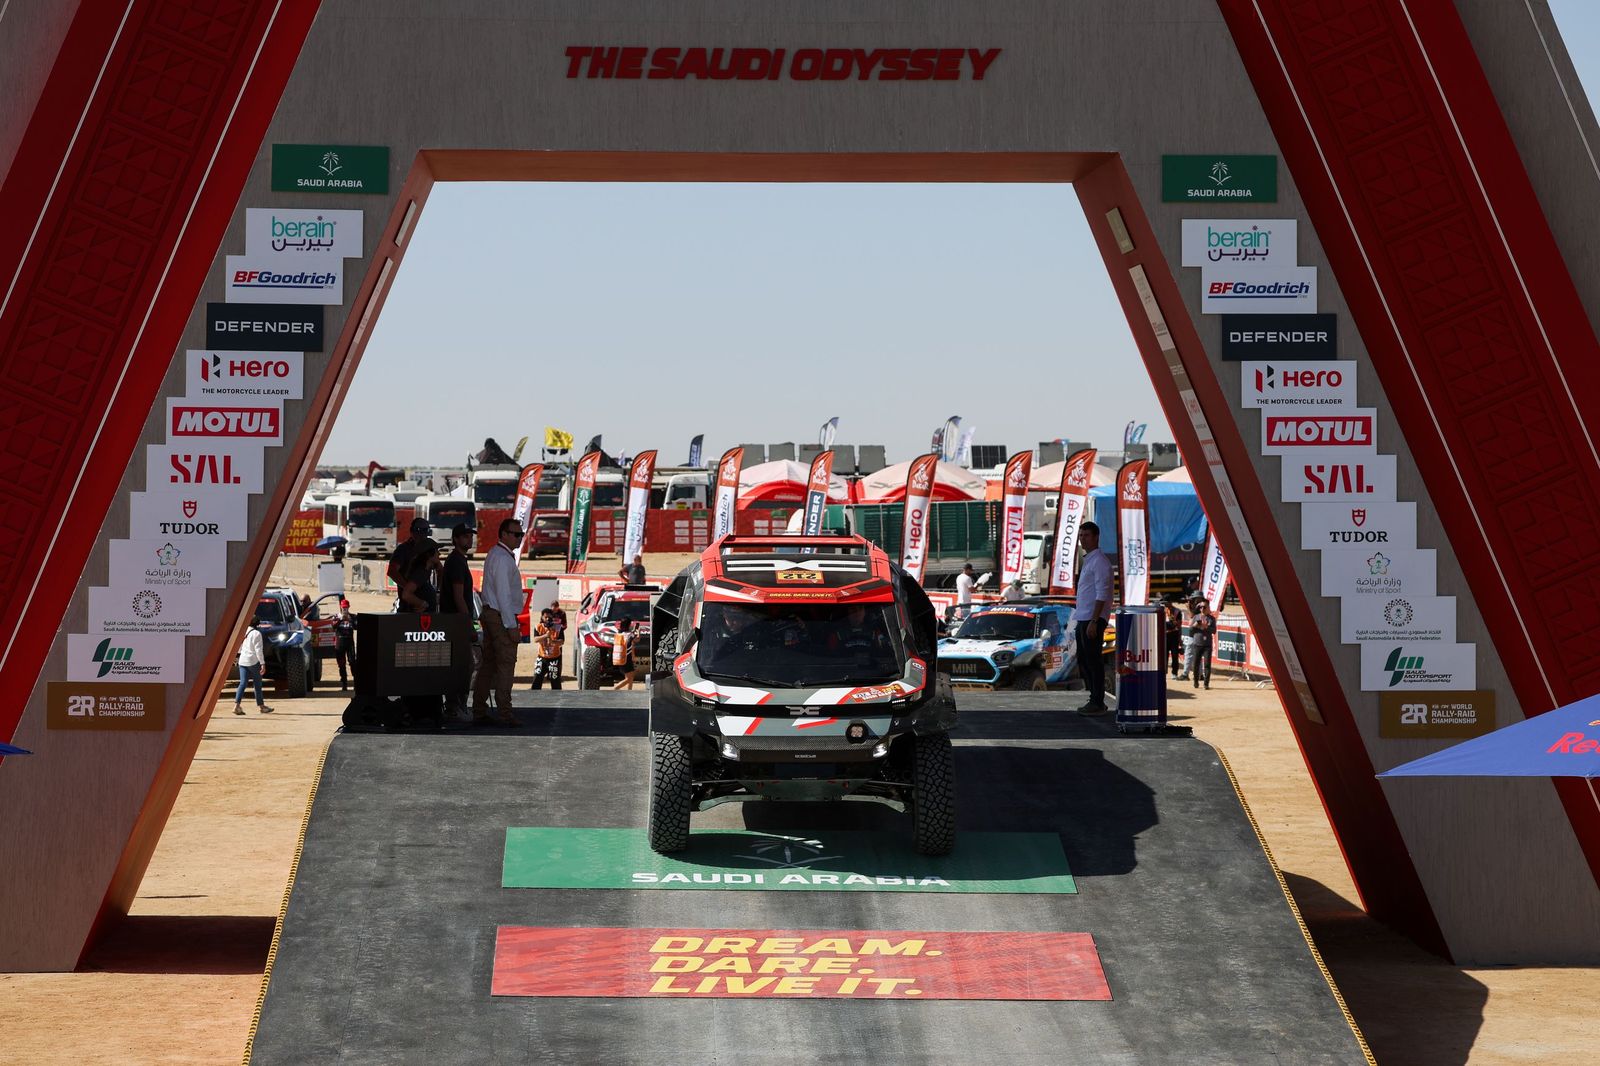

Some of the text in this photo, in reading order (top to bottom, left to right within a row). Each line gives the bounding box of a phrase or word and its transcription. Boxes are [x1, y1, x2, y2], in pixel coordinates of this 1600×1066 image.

[564, 46, 1002, 81] THE SAUDI ODYSSEY
[297, 178, 363, 188] SAUDI ARABIA
[1187, 189, 1252, 197] SAUDI ARABIA
[272, 215, 334, 238] berain
[1208, 225, 1269, 247] berain
[272, 238, 334, 252] بيرين
[1208, 247, 1269, 262] بيرين
[233, 270, 336, 285] BFGoodrich
[1209, 282, 1309, 294] BFGoodrich
[215, 320, 315, 334] DEFENDER
[1230, 331, 1328, 342] DEFENDER
[229, 360, 289, 378] Hero
[1283, 370, 1342, 387] Hero
[177, 411, 275, 434] MOTUL
[1271, 420, 1367, 442] MOTUL
[159, 523, 219, 535] TUDOR
[292, 519, 324, 528] REAM
[577, 508, 585, 538] ARABIA
[285, 538, 310, 546] LIVE
[1007, 509, 1022, 570] MOTUL
[1061, 514, 1077, 567] TUDOR
[1329, 531, 1388, 542] TUDOR
[404, 631, 446, 642] TUDOR
[1218, 640, 1246, 653] DEFENDER
[1123, 649, 1149, 663] Bull
[952, 663, 977, 674] MINI
[1431, 710, 1476, 718] RALLY-RAID
[632, 872, 952, 887] SAUDI ARABIA
[648, 936, 945, 956] DREAM.
[648, 956, 876, 974] DARE.
[648, 976, 924, 995] LIVE IT.
